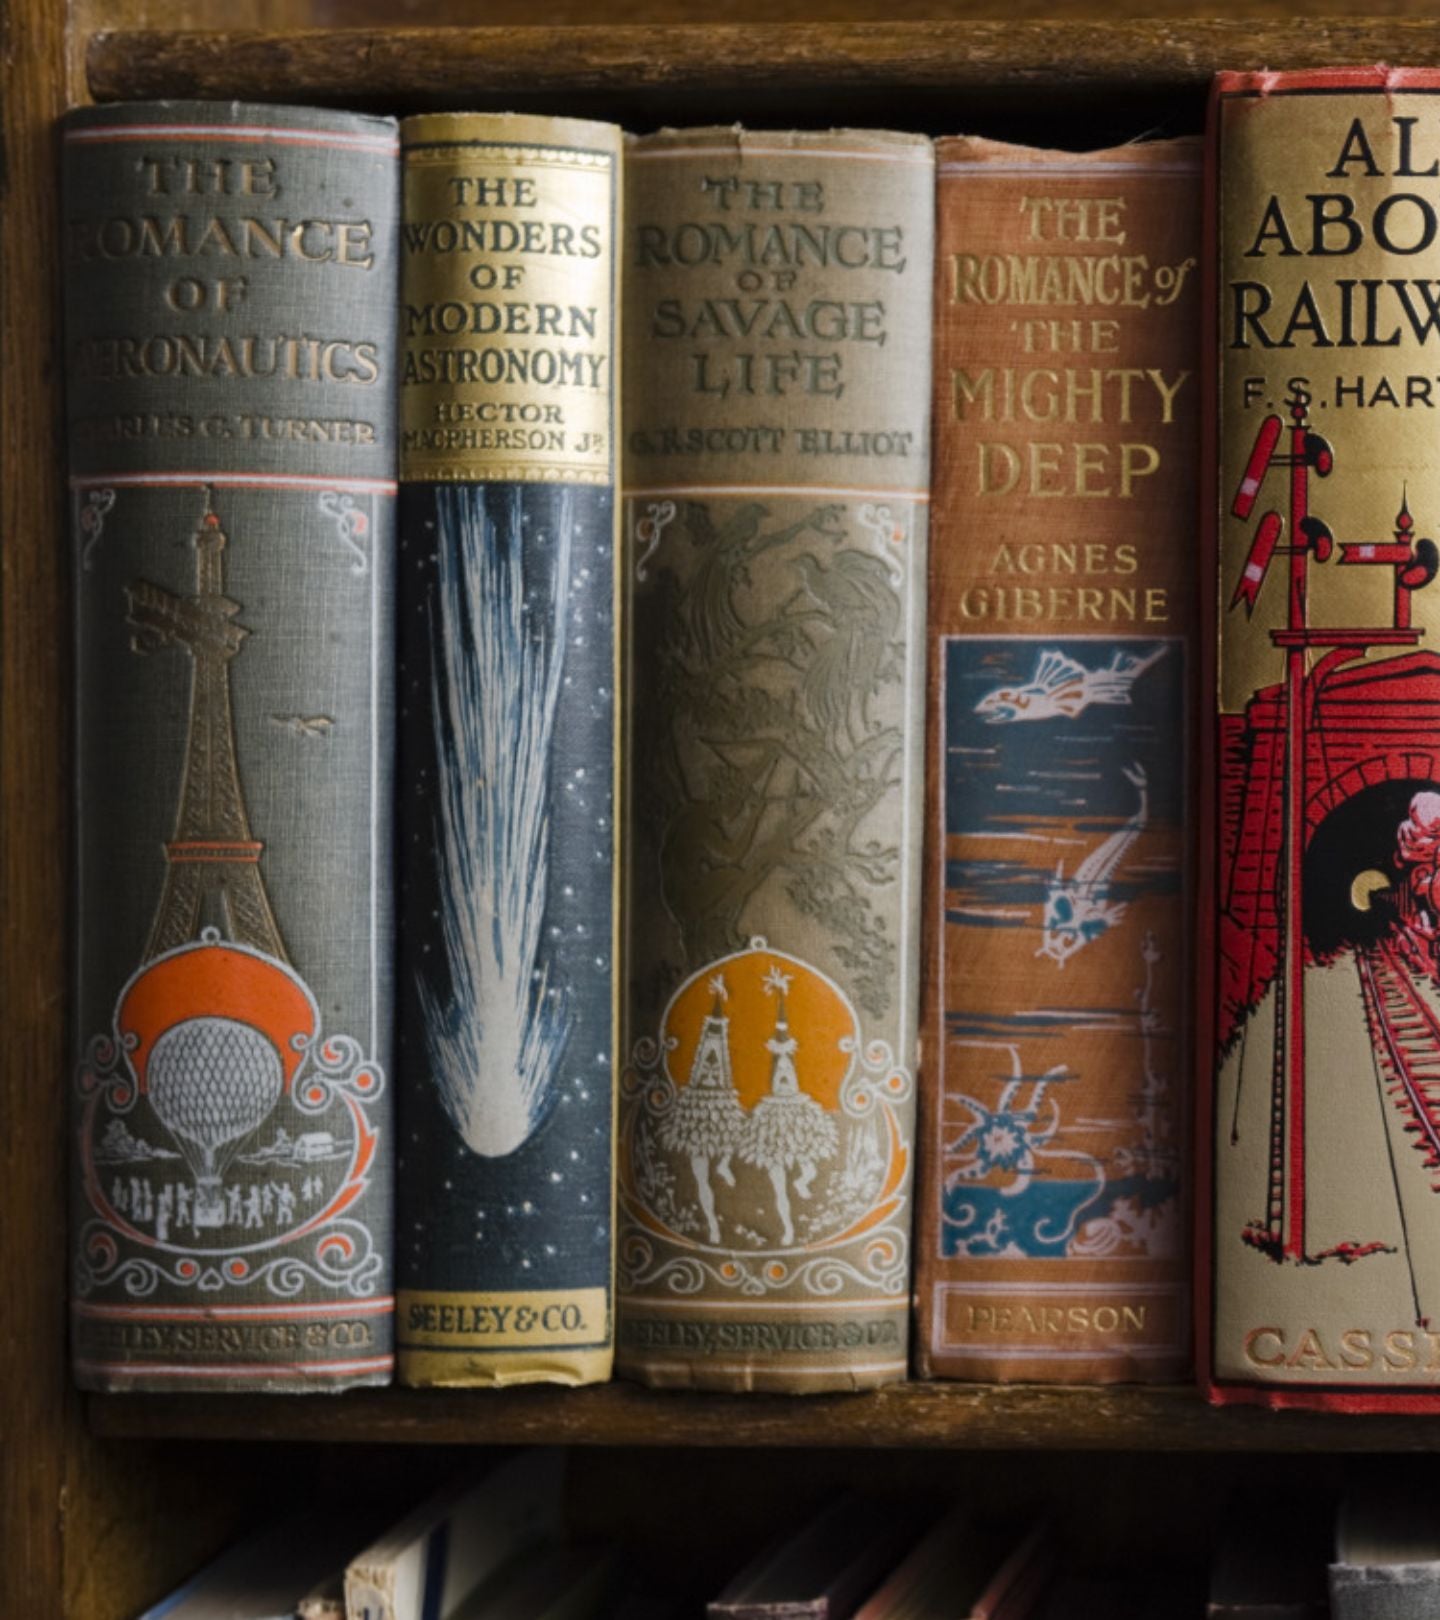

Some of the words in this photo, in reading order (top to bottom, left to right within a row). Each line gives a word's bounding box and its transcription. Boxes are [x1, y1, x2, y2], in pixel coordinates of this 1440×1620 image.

[135, 156, 279, 199] THE
[450, 176, 538, 208] THE
[701, 176, 825, 213] THE
[402, 219, 602, 259] WONDERS
[1019, 196, 1126, 247] THE
[633, 222, 907, 273] ROMANCE
[165, 275, 248, 312] OF
[469, 264, 526, 290] OF
[737, 270, 798, 293] OF
[949, 254, 1151, 309] ROMANCE
[1154, 257, 1197, 305] of
[405, 302, 598, 338] MODERN
[650, 298, 887, 346] SAVAGE
[1010, 320, 1122, 354] THE
[402, 347, 606, 389] ASTRONOMY
[691, 351, 845, 400] LIFE
[435, 402, 566, 425] HECTOR
[949, 368, 1192, 424] MIGHTY
[238, 415, 377, 445] TURNER
[402, 429, 566, 452] MACPHERSON
[795, 428, 914, 456] ELLIOT
[975, 441, 1161, 498] DEEP
[988, 543, 1138, 576] AGNES
[960, 586, 1169, 622] GIBERNE
[966, 1304, 1147, 1334] PEARSON
